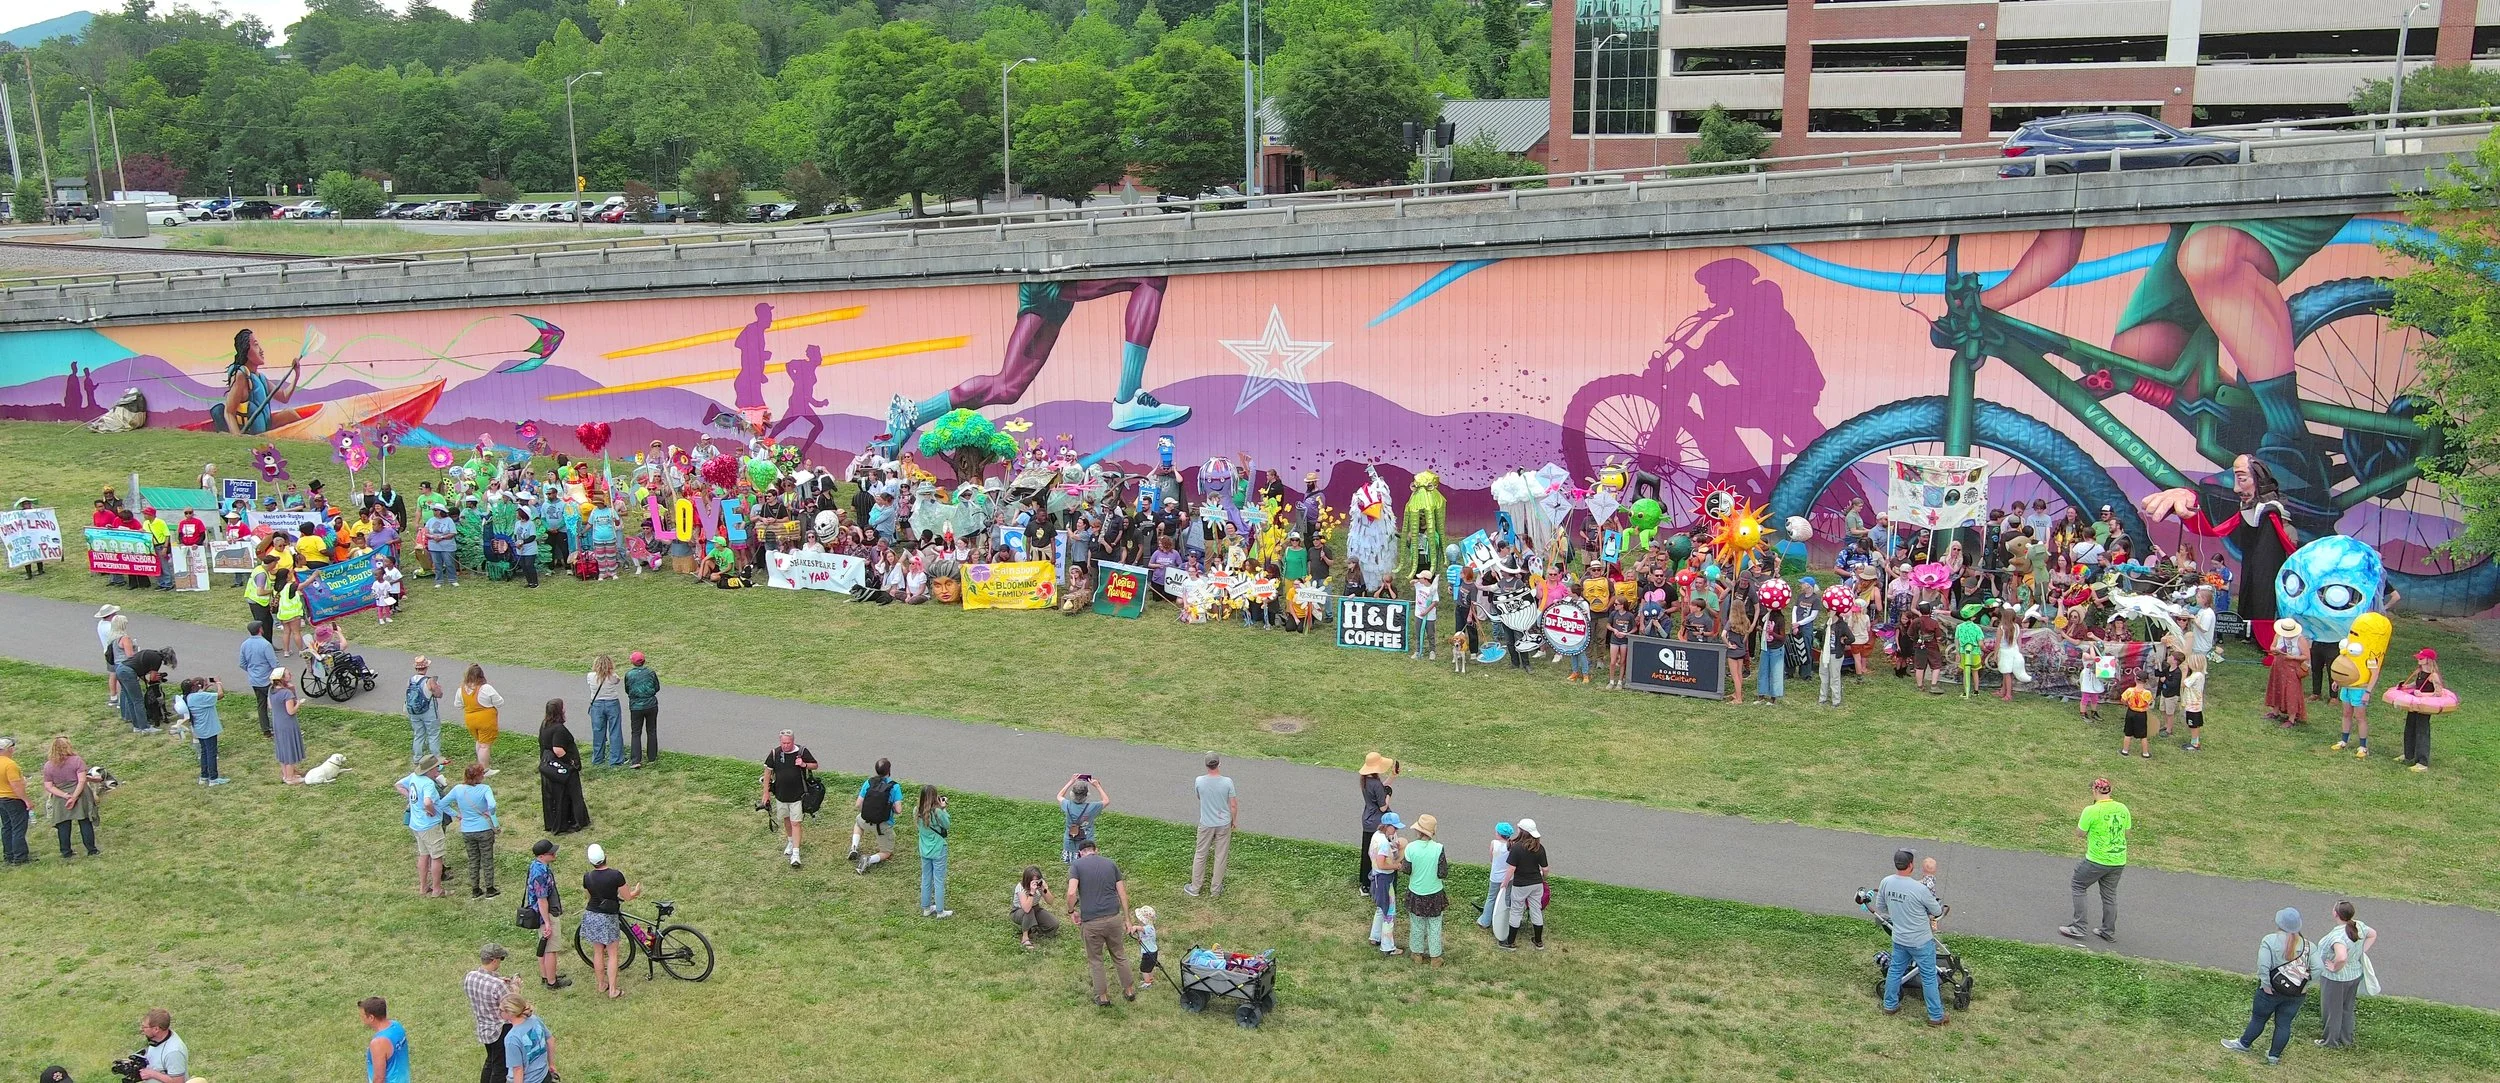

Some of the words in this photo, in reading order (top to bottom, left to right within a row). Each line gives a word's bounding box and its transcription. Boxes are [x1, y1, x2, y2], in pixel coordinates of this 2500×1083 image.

[2083, 403, 2171, 478] VICTORY
[258, 520, 297, 528] Neighborhood
[647, 495, 748, 542] LOVE
[92, 551, 119, 562] HISTORIC
[133, 564, 157, 572] DISTRICT
[789, 558, 837, 570] SHAKESPEARE
[320, 565, 344, 581] Royal
[809, 571, 829, 584] YARD
[326, 578, 348, 590] Dare
[347, 568, 374, 583] Bears
[995, 579, 1038, 590] BLOOMING
[997, 590, 1024, 598] FAMILY
[1552, 607, 1561, 615] 10
[1545, 616, 1557, 626] Dr
[1556, 616, 1586, 633] Pepper
[1344, 629, 1402, 649] COFFEE
[1675, 650, 1687, 661] IT'S
[1674, 660, 1689, 671] HERE
[1888, 891, 1907, 900] ARIAT
